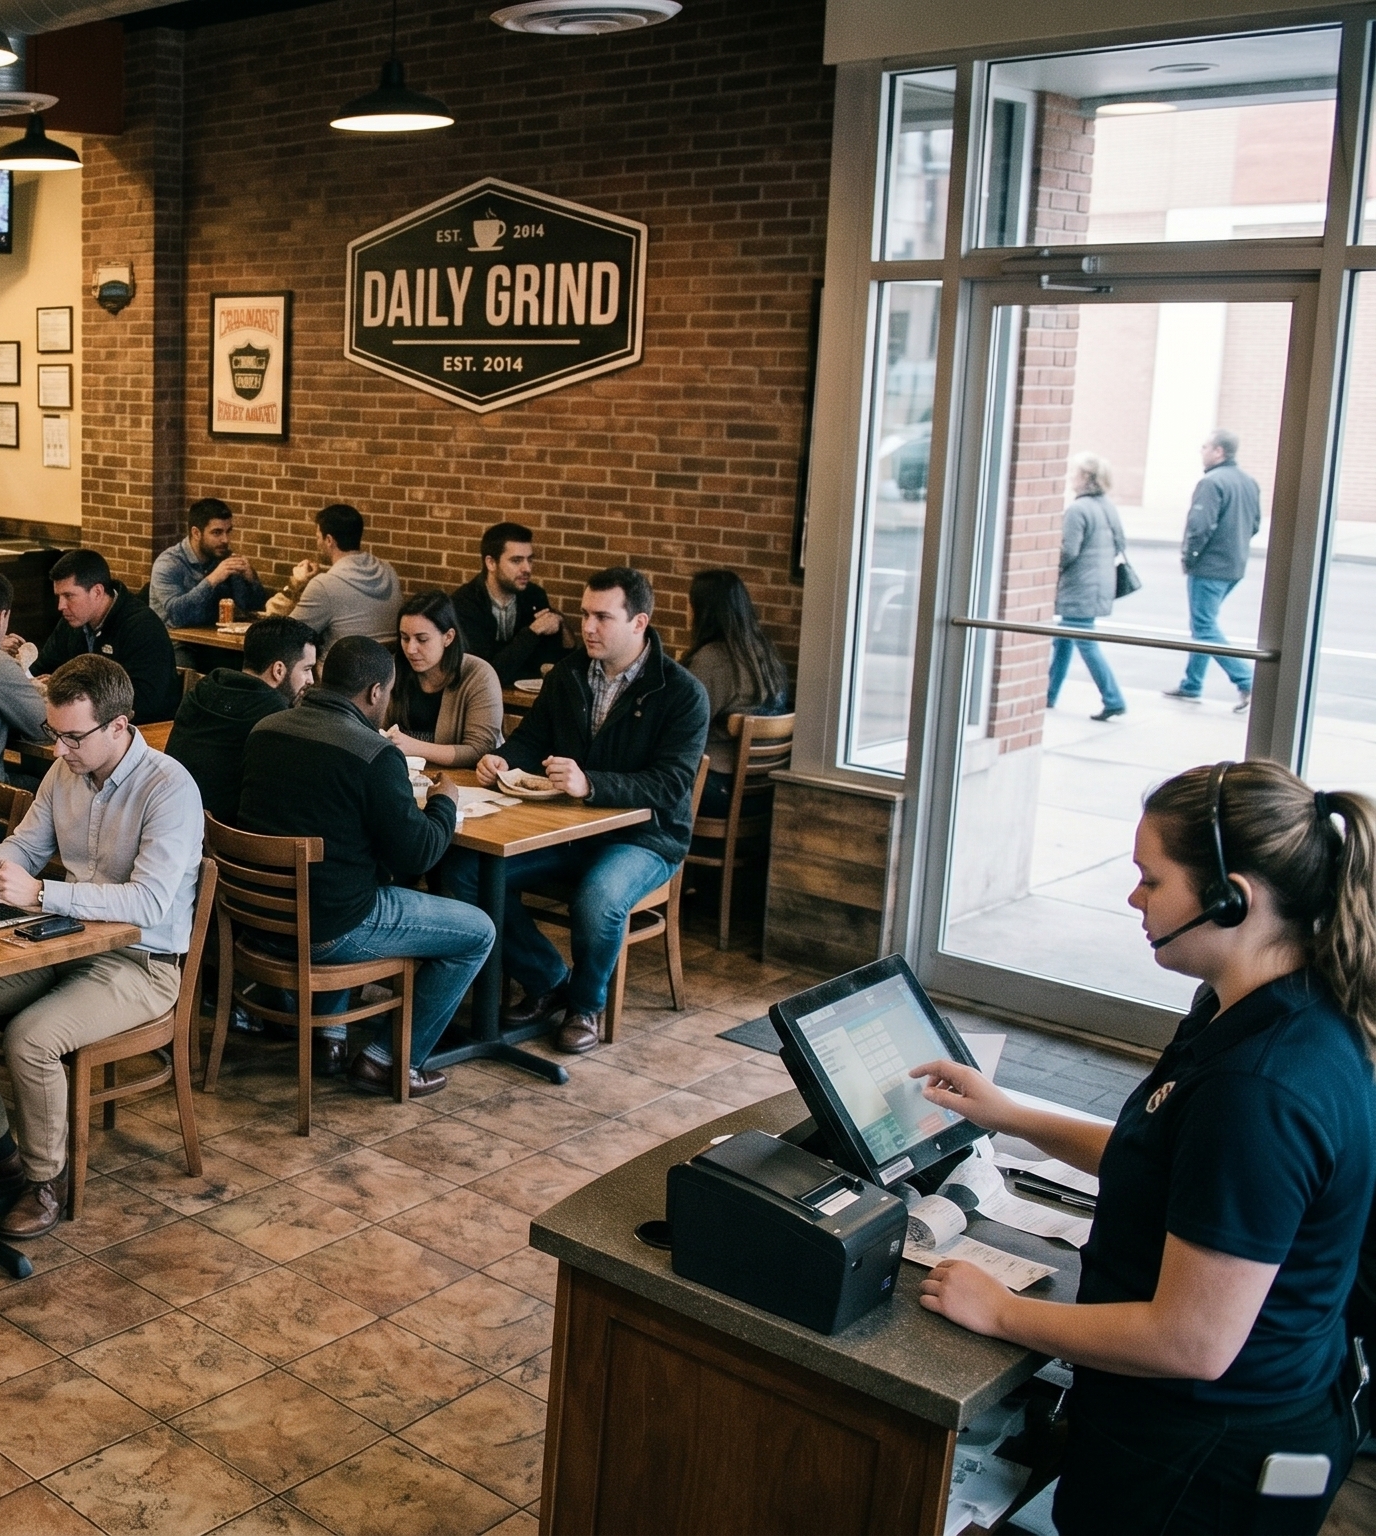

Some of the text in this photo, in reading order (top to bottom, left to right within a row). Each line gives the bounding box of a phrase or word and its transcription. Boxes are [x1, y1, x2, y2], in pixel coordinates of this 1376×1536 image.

[436, 224, 545, 243] EST. 2014
[363, 261, 620, 327] DAILY GRIND
[443, 357, 523, 372] EST. 2014
